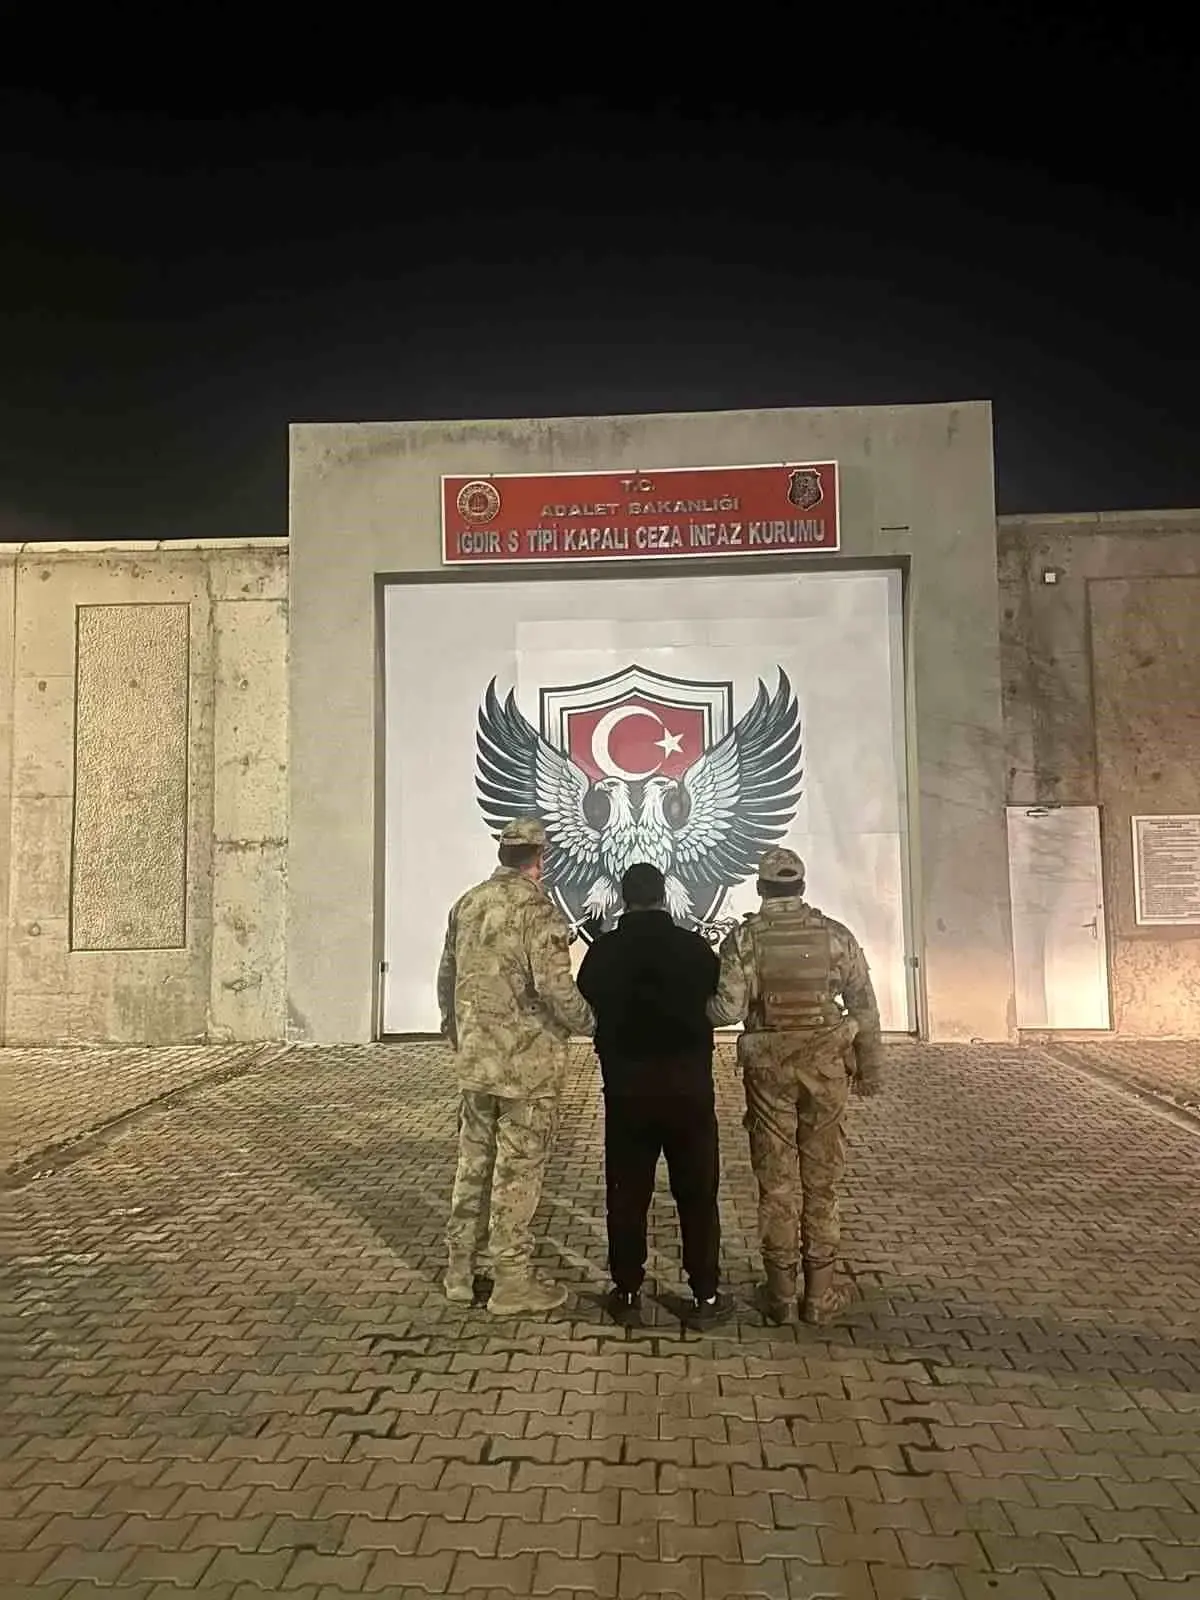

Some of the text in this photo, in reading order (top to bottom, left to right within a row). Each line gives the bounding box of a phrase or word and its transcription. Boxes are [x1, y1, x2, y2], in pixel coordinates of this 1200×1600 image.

[541, 494, 739, 517] ADALET BAKANLIĞI
[507, 528, 519, 553] S
[527, 523, 558, 552] TİPİ
[563, 527, 629, 551] KAPALI
[636, 525, 683, 549] CEZA
[689, 518, 742, 546] İNFAZ
[748, 519, 825, 545] KURUMU
